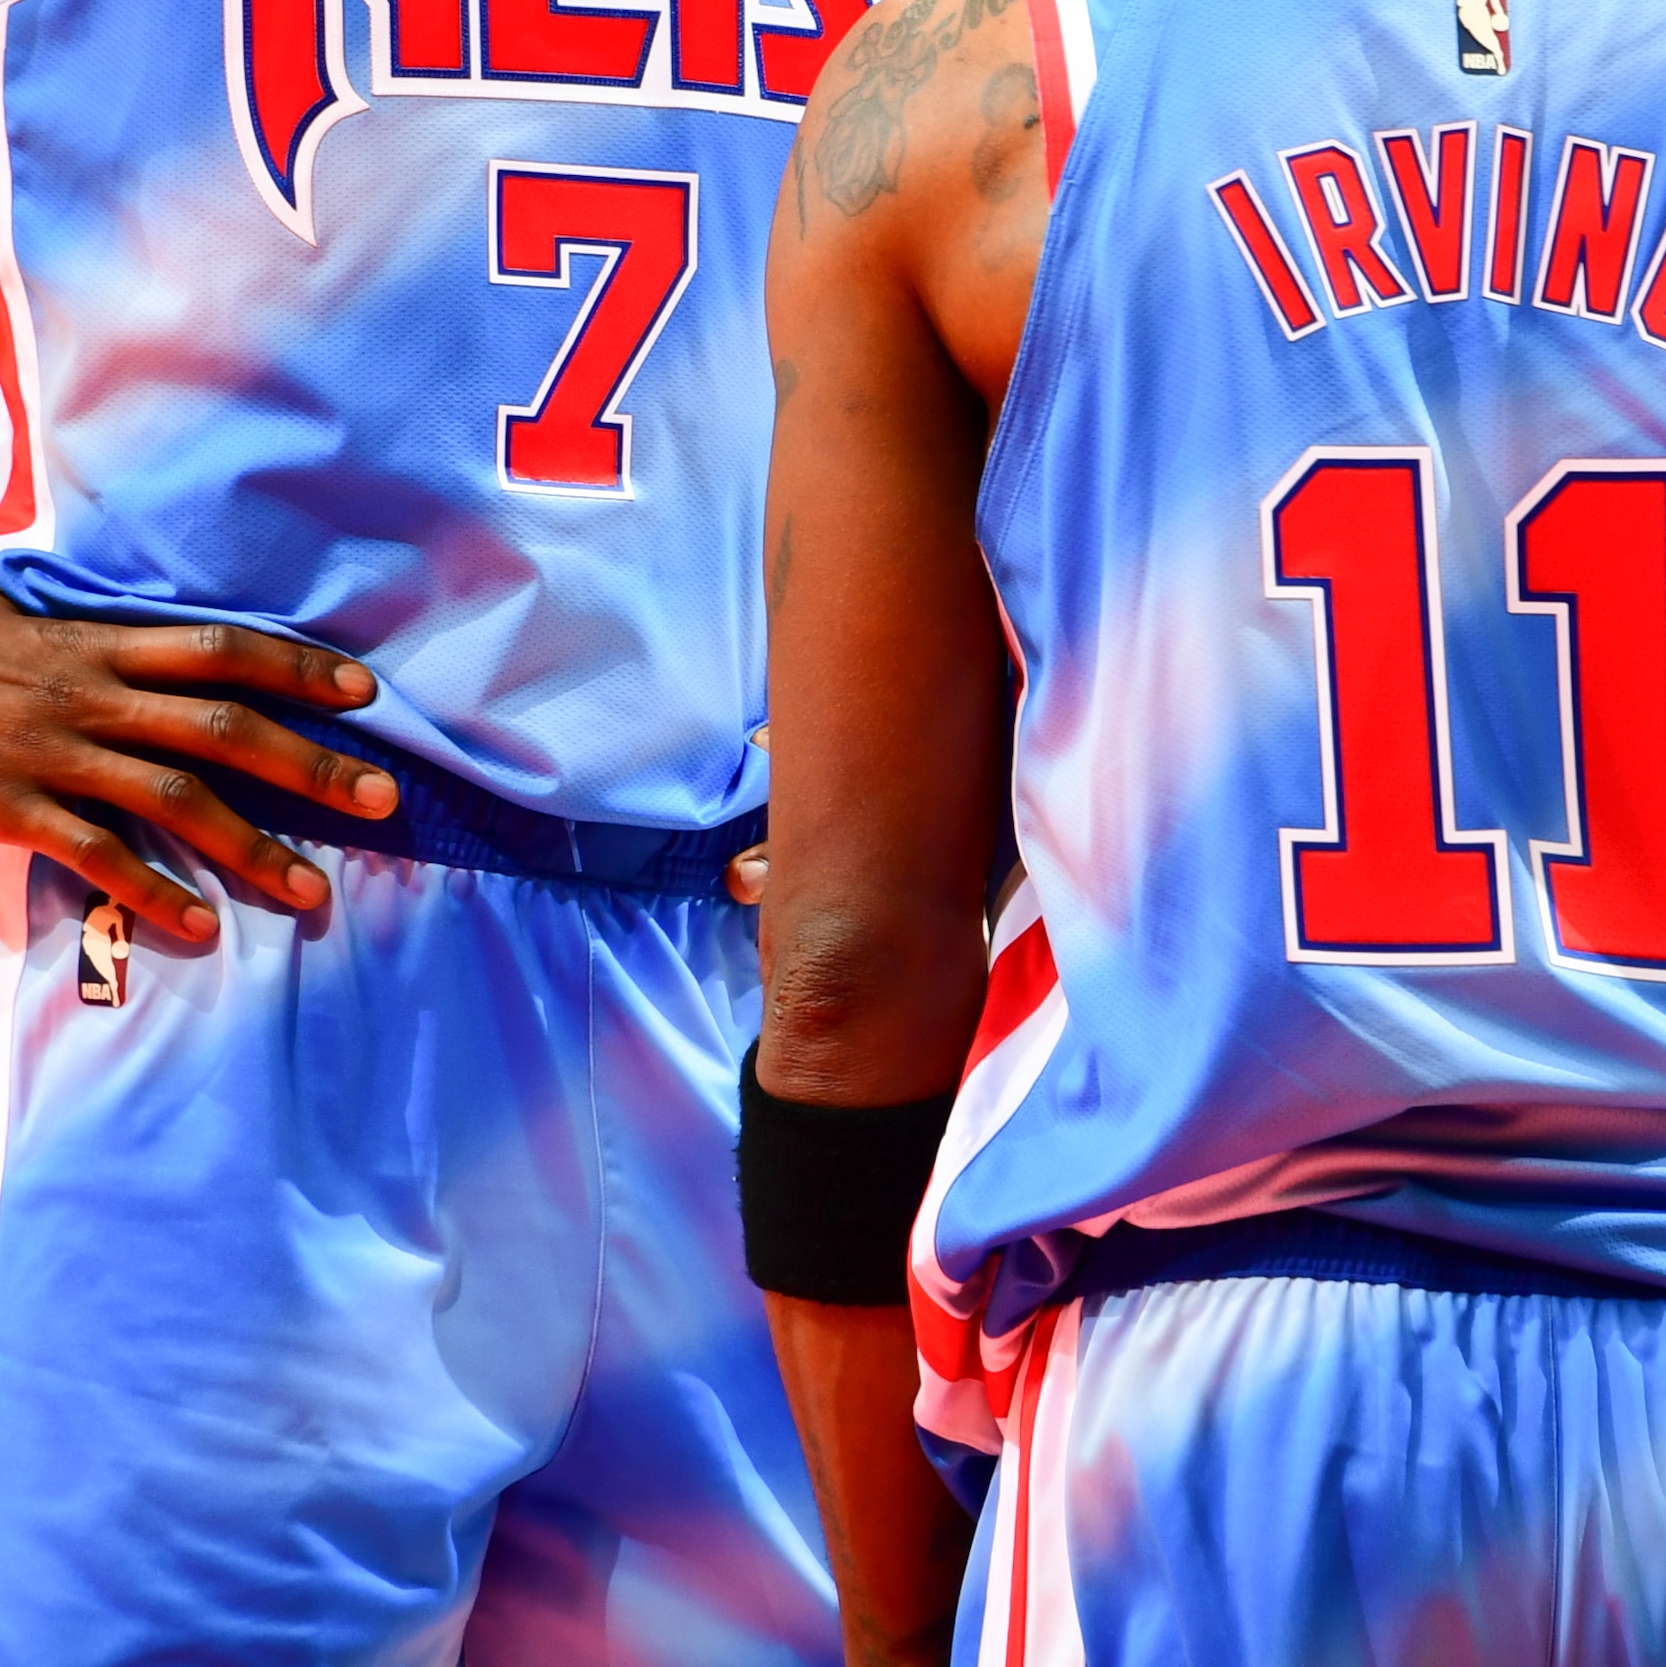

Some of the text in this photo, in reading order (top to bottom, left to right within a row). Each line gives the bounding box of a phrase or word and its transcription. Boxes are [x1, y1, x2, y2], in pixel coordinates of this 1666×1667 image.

[1462, 52, 1498, 70] NBA
[489, 160, 699, 500] 7
[81, 982, 112, 1001] NBA
